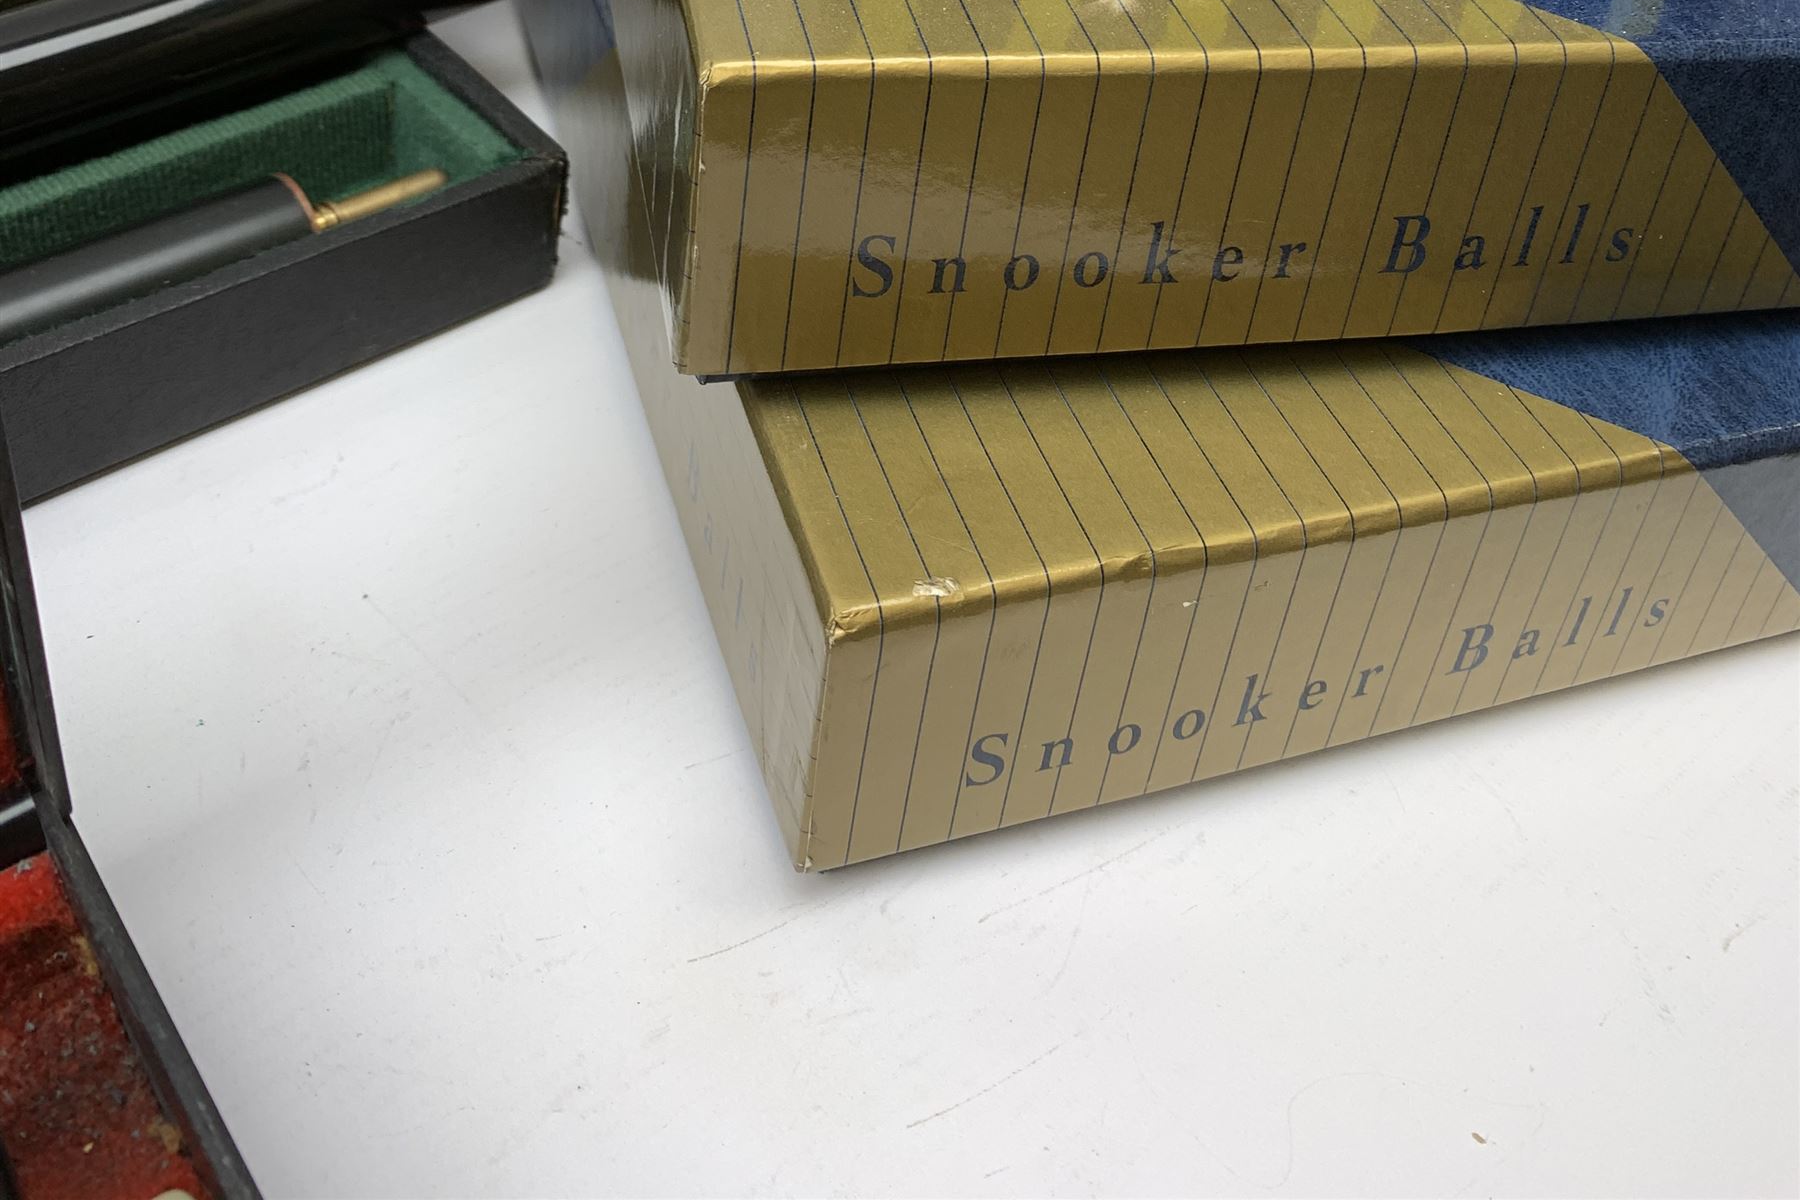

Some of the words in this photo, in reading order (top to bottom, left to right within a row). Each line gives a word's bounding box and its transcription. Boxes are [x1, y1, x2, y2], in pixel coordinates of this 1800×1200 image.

[852, 221, 1308, 298] Snooker
[1377, 203, 1635, 274] Balls
[965, 664, 1385, 788] Snooker
[1444, 586, 1670, 676] Balls
